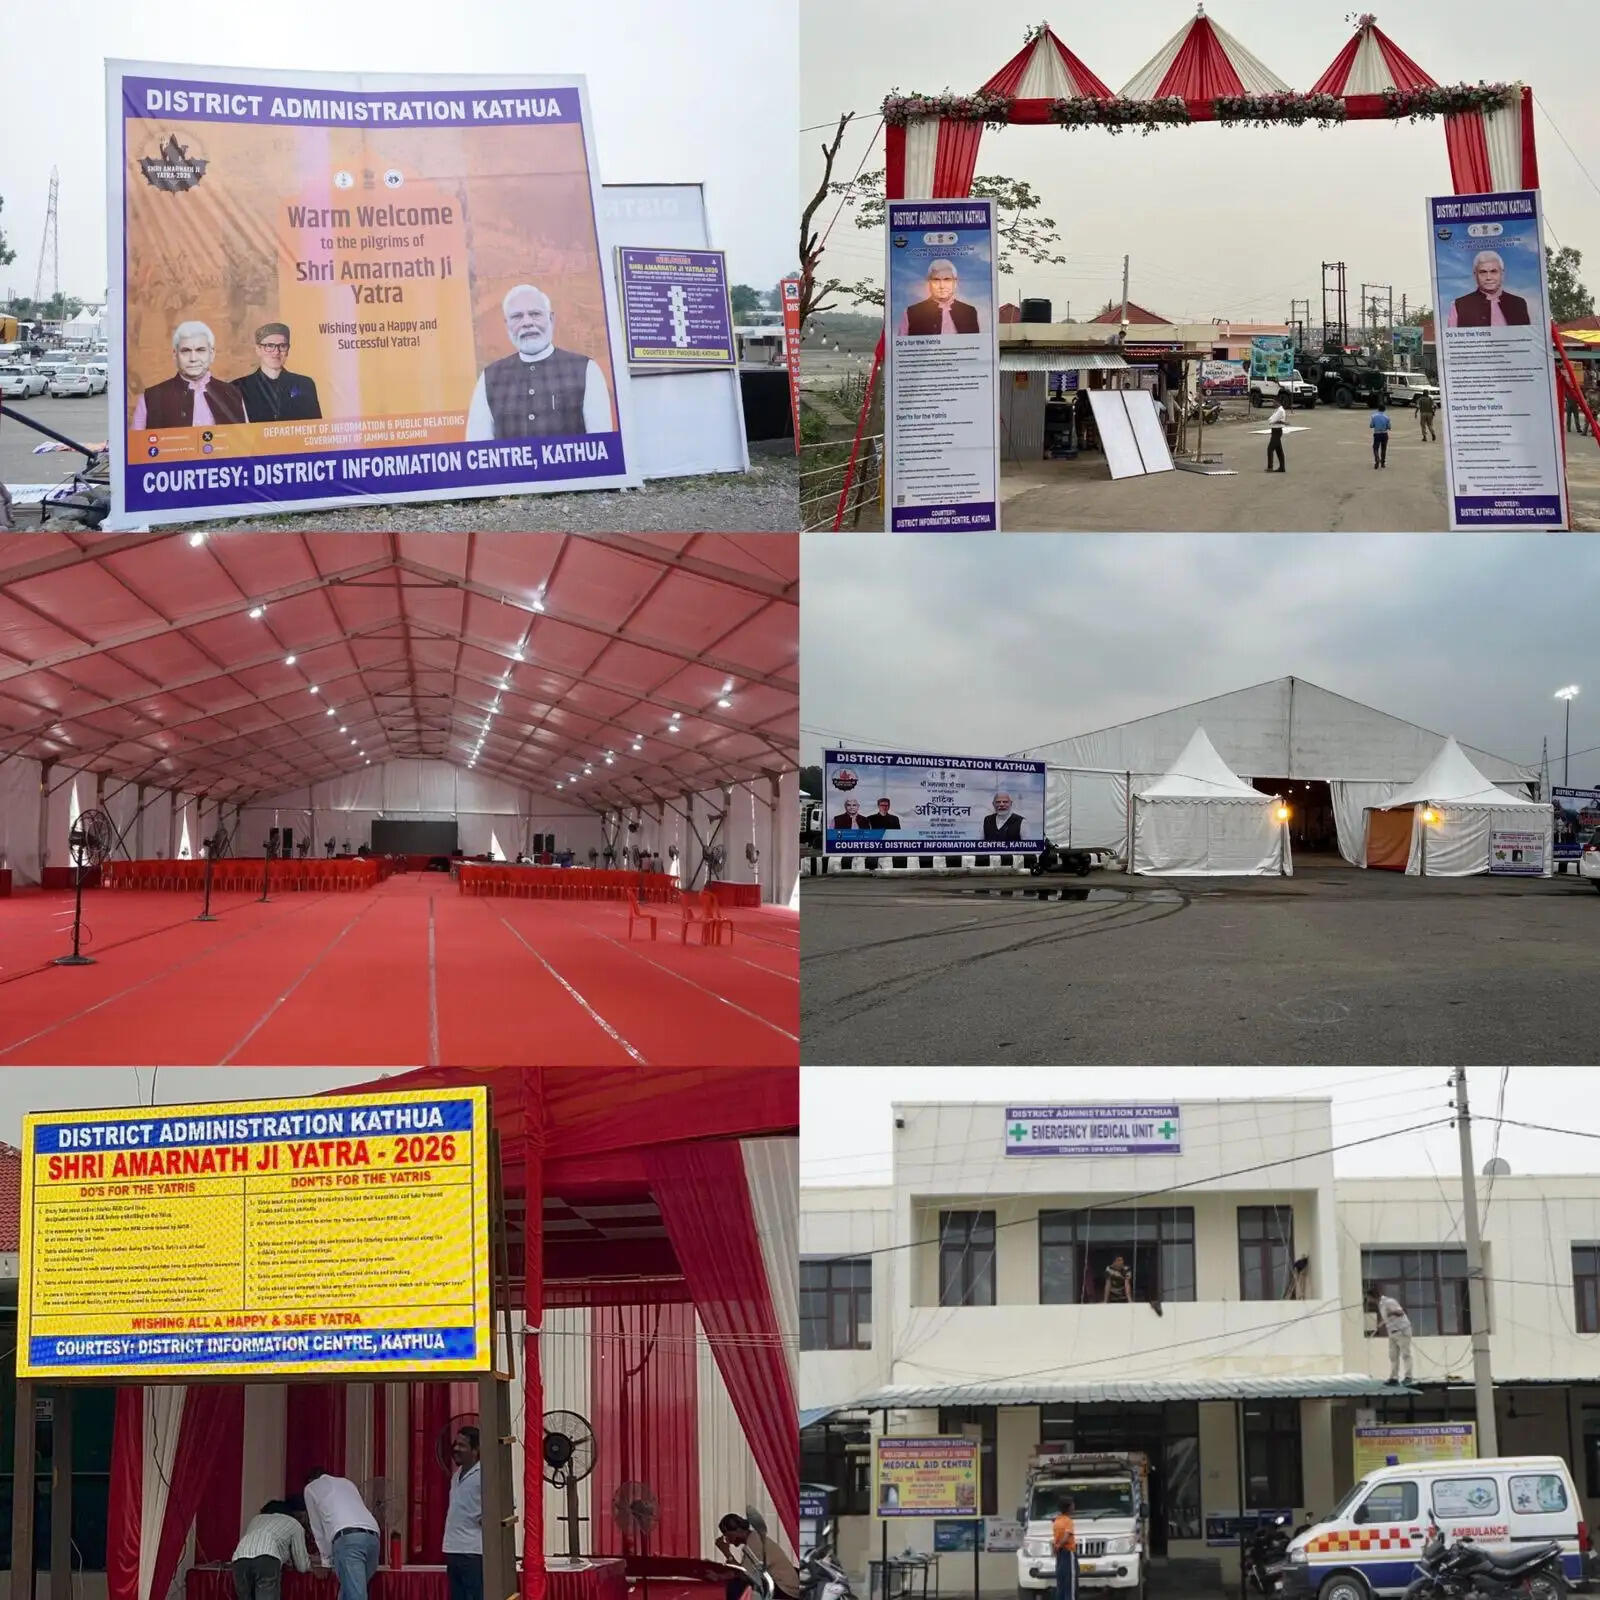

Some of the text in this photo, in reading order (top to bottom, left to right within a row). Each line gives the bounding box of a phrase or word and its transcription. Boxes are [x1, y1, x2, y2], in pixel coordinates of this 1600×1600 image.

[147, 89, 561, 121] DISTRICT ADMINISTRATION KATHUA
[288, 204, 453, 228] Warm Welcome
[1436, 199, 1532, 219] DISTRICT ADMINISTRATION KATHUA
[893, 210, 987, 226] DISTRICT ADMINISTRATION KATHUA
[321, 234, 425, 251] to the pilgrims of
[296, 256, 452, 282] Shri Amarnath Ji
[351, 284, 403, 304] Yatra
[319, 318, 437, 335] Wishing you a Happy and
[338, 335, 420, 350] Successful Yatra!
[263, 424, 317, 439] DEPARTMENT
[319, 423, 328, 434] OF
[331, 420, 385, 433] INFORMATION
[395, 417, 422, 429] PUBLIC
[423, 415, 465, 427] RELATIONS
[304, 434, 351, 446] GOVERNMENT
[364, 432, 388, 443] JAMMU
[143, 440, 609, 494] COURTESY: DISTRICT INFORMATION CENTRE, KATHUA
[1460, 508, 1483, 517] DISTRICT
[1483, 508, 1515, 517] INFORMATION
[1536, 508, 1556, 516] KATHUA
[896, 518, 919, 528] DISTRICT
[919, 517, 951, 527] INFORMATION
[971, 515, 991, 524] KATHUA
[837, 754, 1036, 772] DISTRICT ADMINISTRATION KATHUA
[915, 802, 972, 817] अभिनंदन
[835, 841, 883, 849] COURTESY:
[886, 841, 922, 849] DISTRICT
[923, 841, 976, 849] INFORMATION
[977, 841, 1008, 849] CENTRE,
[1012, 1108, 1173, 1119] DISTRICT ADMINISTRATION KATHUA
[58, 1107, 444, 1148] DISTRICT ADMINISTRATION KATHUA
[1032, 1123, 1154, 1140] EMERGENCY MEDICAL UNIT
[48, 1154, 104, 1181] SHRI
[112, 1146, 249, 1178] AMARNATH
[256, 1145, 278, 1171] JI
[287, 1139, 370, 1169] YATRA
[394, 1135, 456, 1164] 2026
[291, 1170, 431, 1188] DON'TS FOR THE YATRIS
[80, 1182, 196, 1198] DO'S FOR THE YATRIS
[132, 1313, 362, 1330] WISHING ALL A HAPPY & SAFE YATRA
[56, 1333, 445, 1356] COURTESY: DISTRICT INFORMATION CENTRE, KATHUA
[883, 1460, 973, 1469] MEDICAL AID CENTRE
[1451, 1526, 1509, 1537] AMBULANCE
